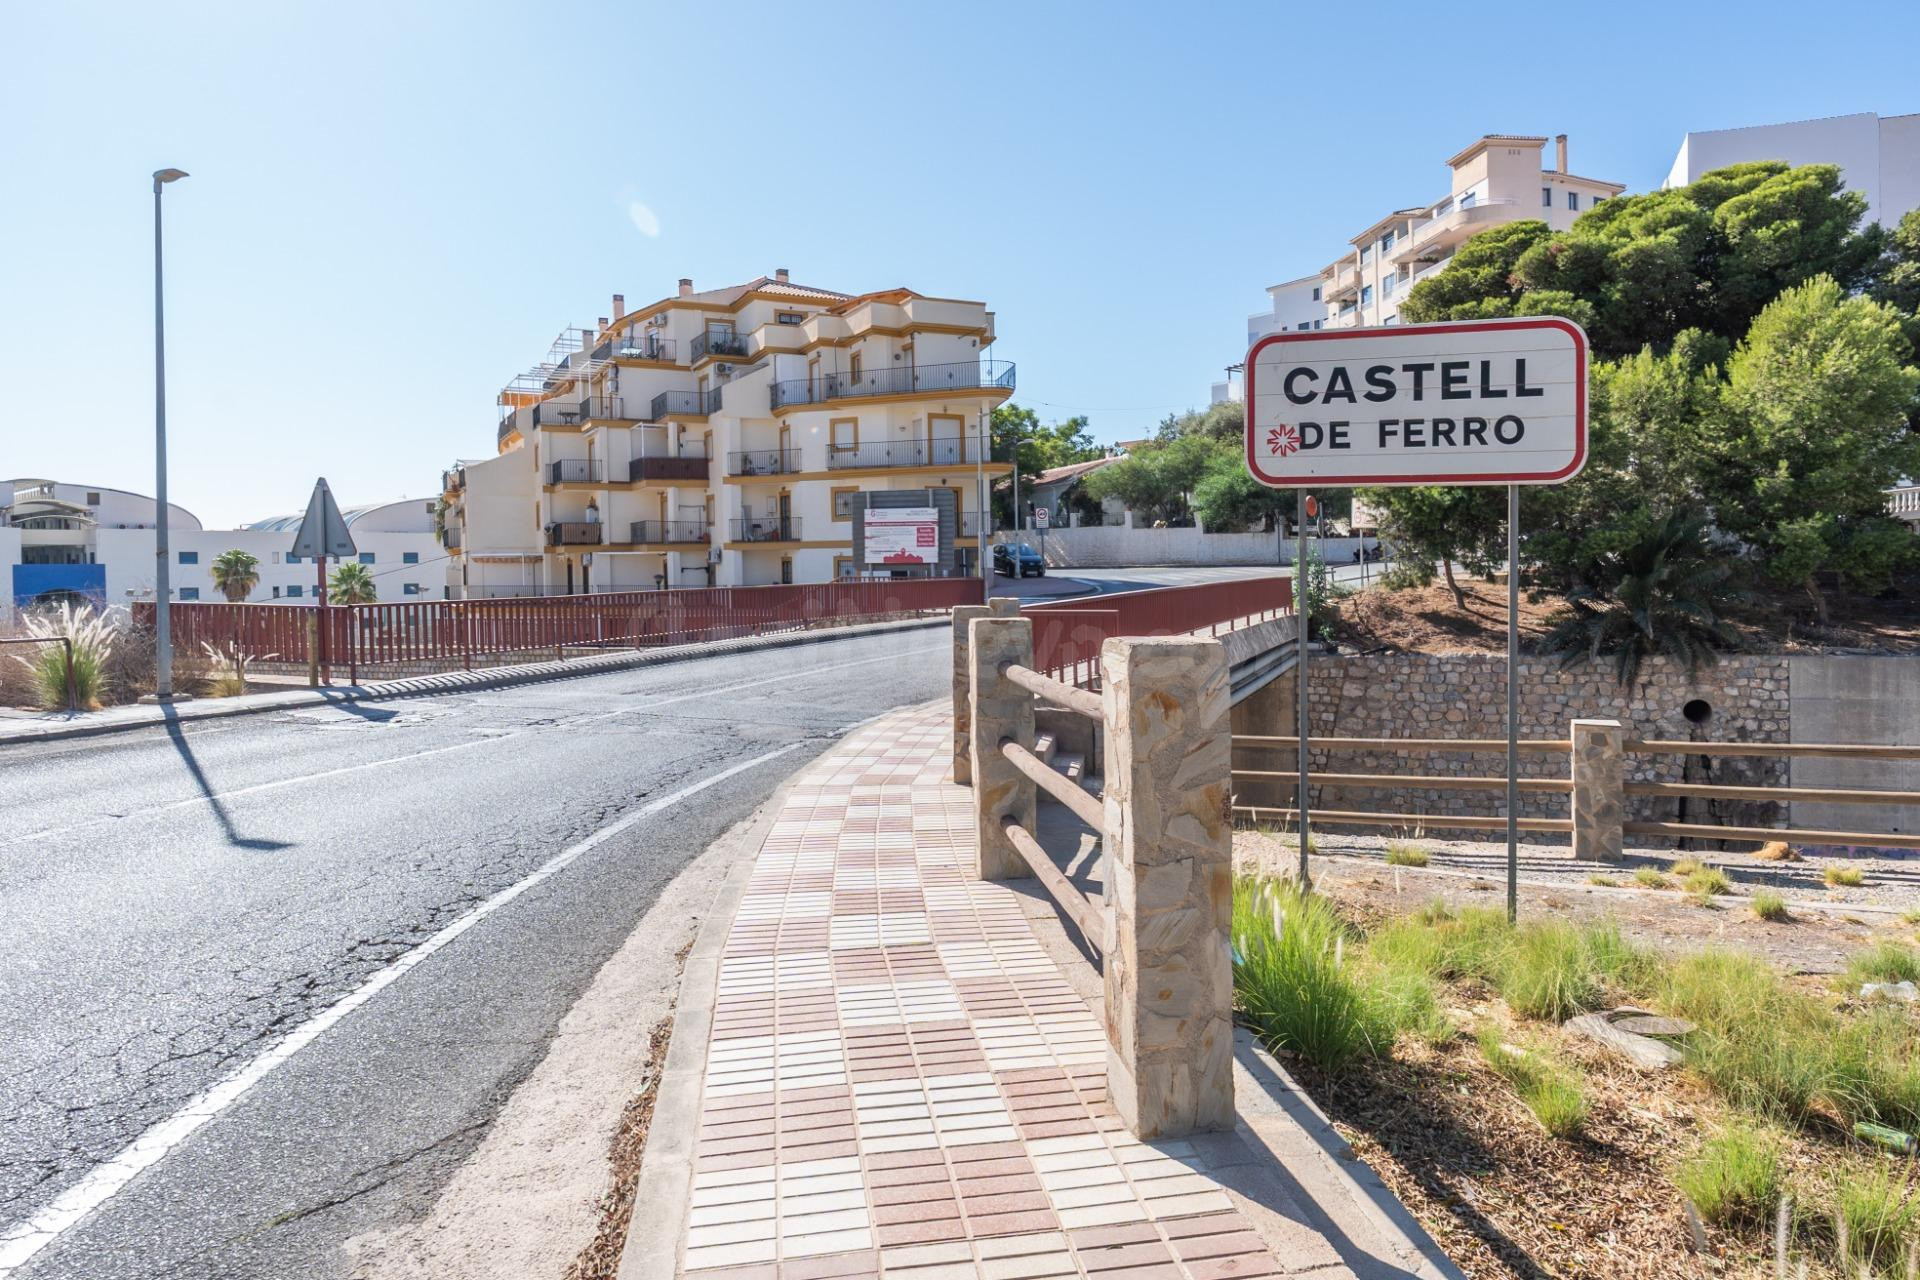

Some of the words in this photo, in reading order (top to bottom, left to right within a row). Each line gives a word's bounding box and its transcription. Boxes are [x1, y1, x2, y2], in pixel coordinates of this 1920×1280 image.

[1283, 358, 1543, 404] CASTELL
[1299, 420, 1350, 450] DE
[1378, 415, 1525, 448] FERRO
